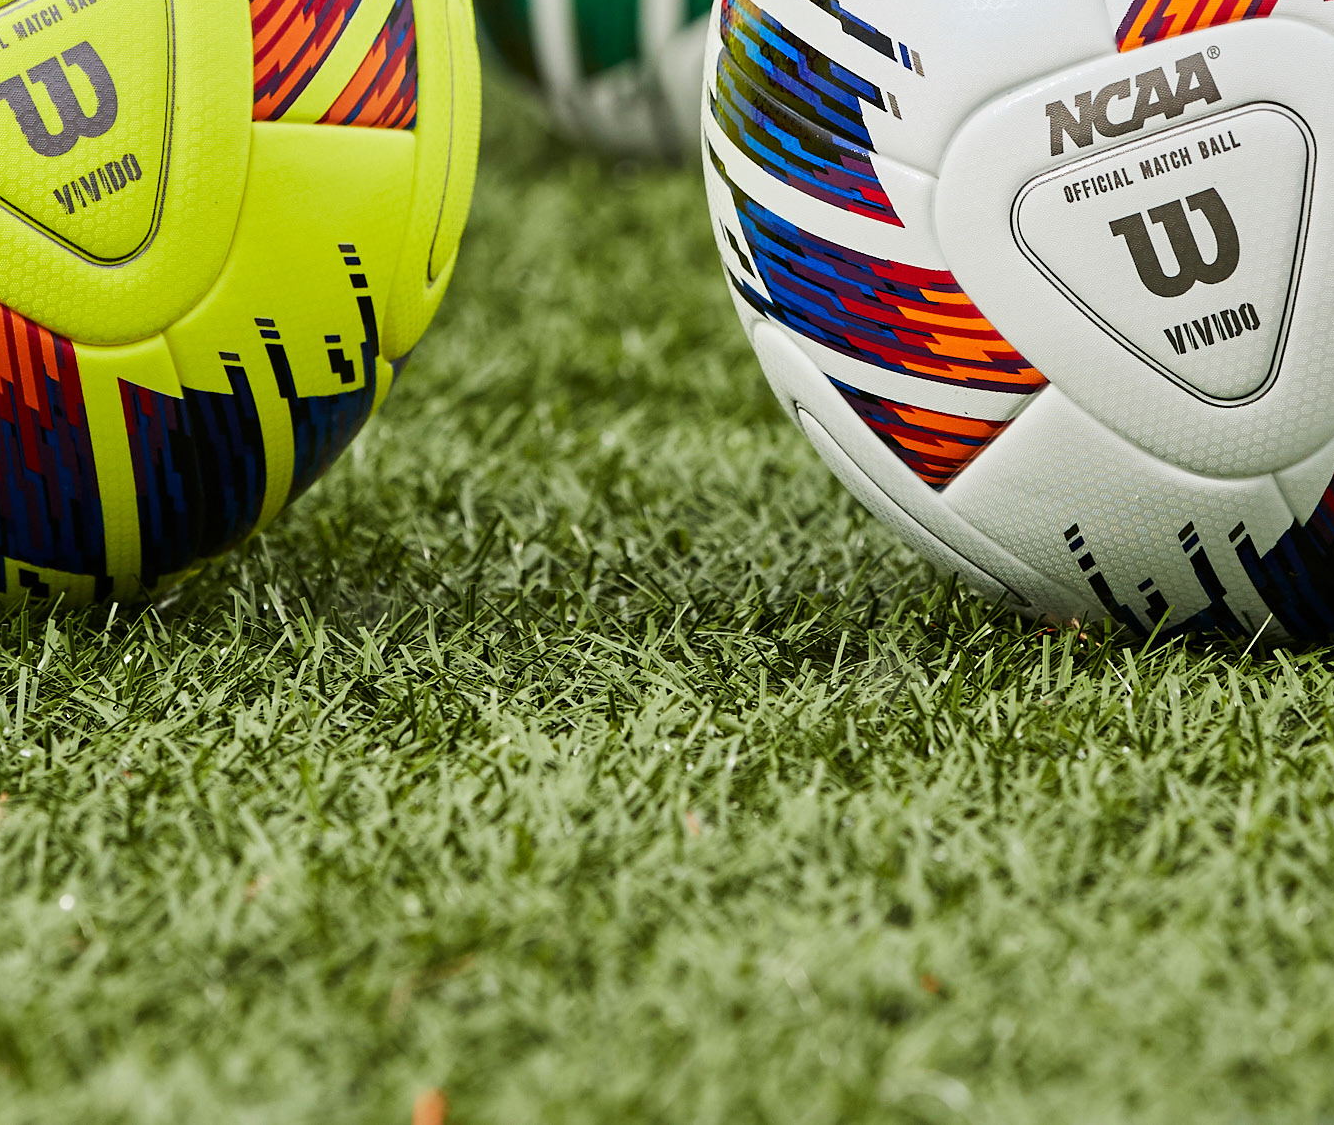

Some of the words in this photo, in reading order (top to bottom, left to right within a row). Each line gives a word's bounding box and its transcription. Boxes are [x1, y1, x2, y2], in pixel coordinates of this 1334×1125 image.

[13, 4, 63, 40] MATCH
[53, 153, 142, 215] VIVIDO
[1063, 168, 1133, 203] OFFICIAL
[1139, 147, 1192, 179] MATCH
[1198, 130, 1240, 160] BALL
[1163, 302, 1260, 355] VIVIDO
